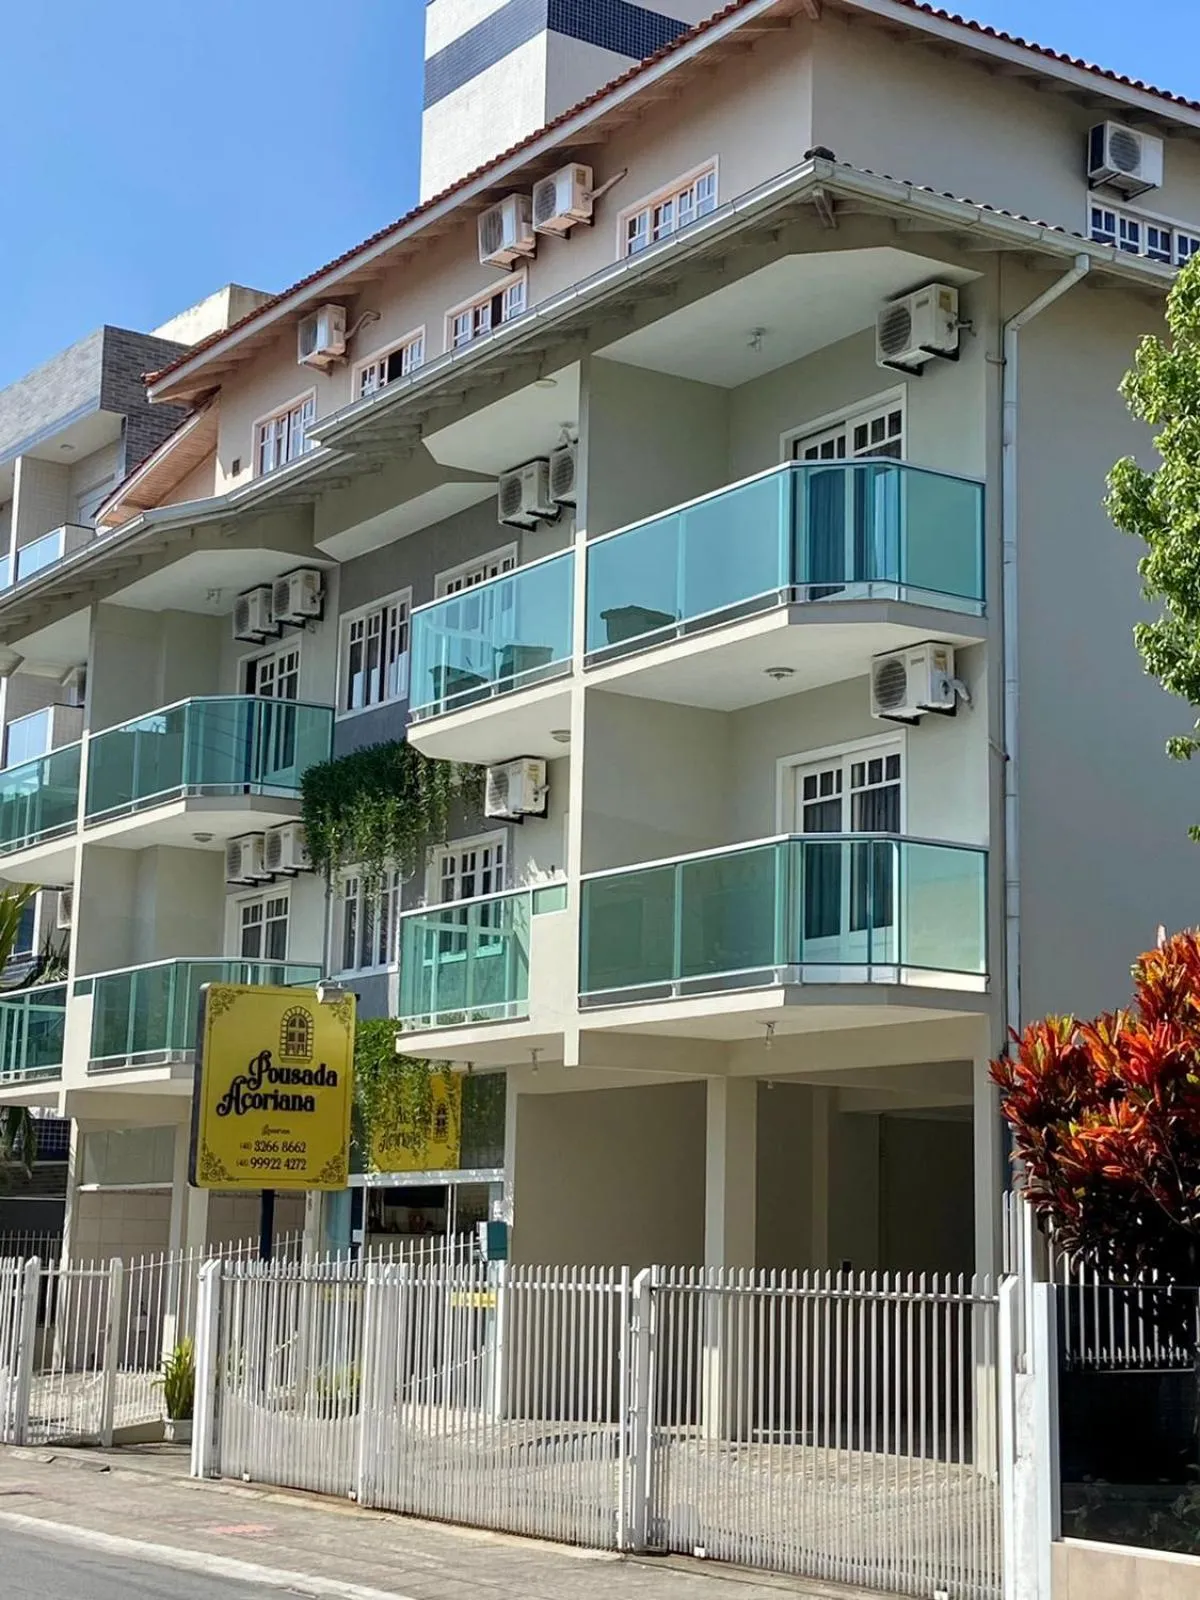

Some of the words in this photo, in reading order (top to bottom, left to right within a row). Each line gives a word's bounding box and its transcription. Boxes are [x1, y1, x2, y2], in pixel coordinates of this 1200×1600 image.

[247, 1050, 338, 1091] Pousada
[254, 1140, 279, 1153] 3266
[281, 1141, 307, 1153] 8662
[250, 1157, 282, 1170] 99922
[284, 1158, 307, 1170] 4272
